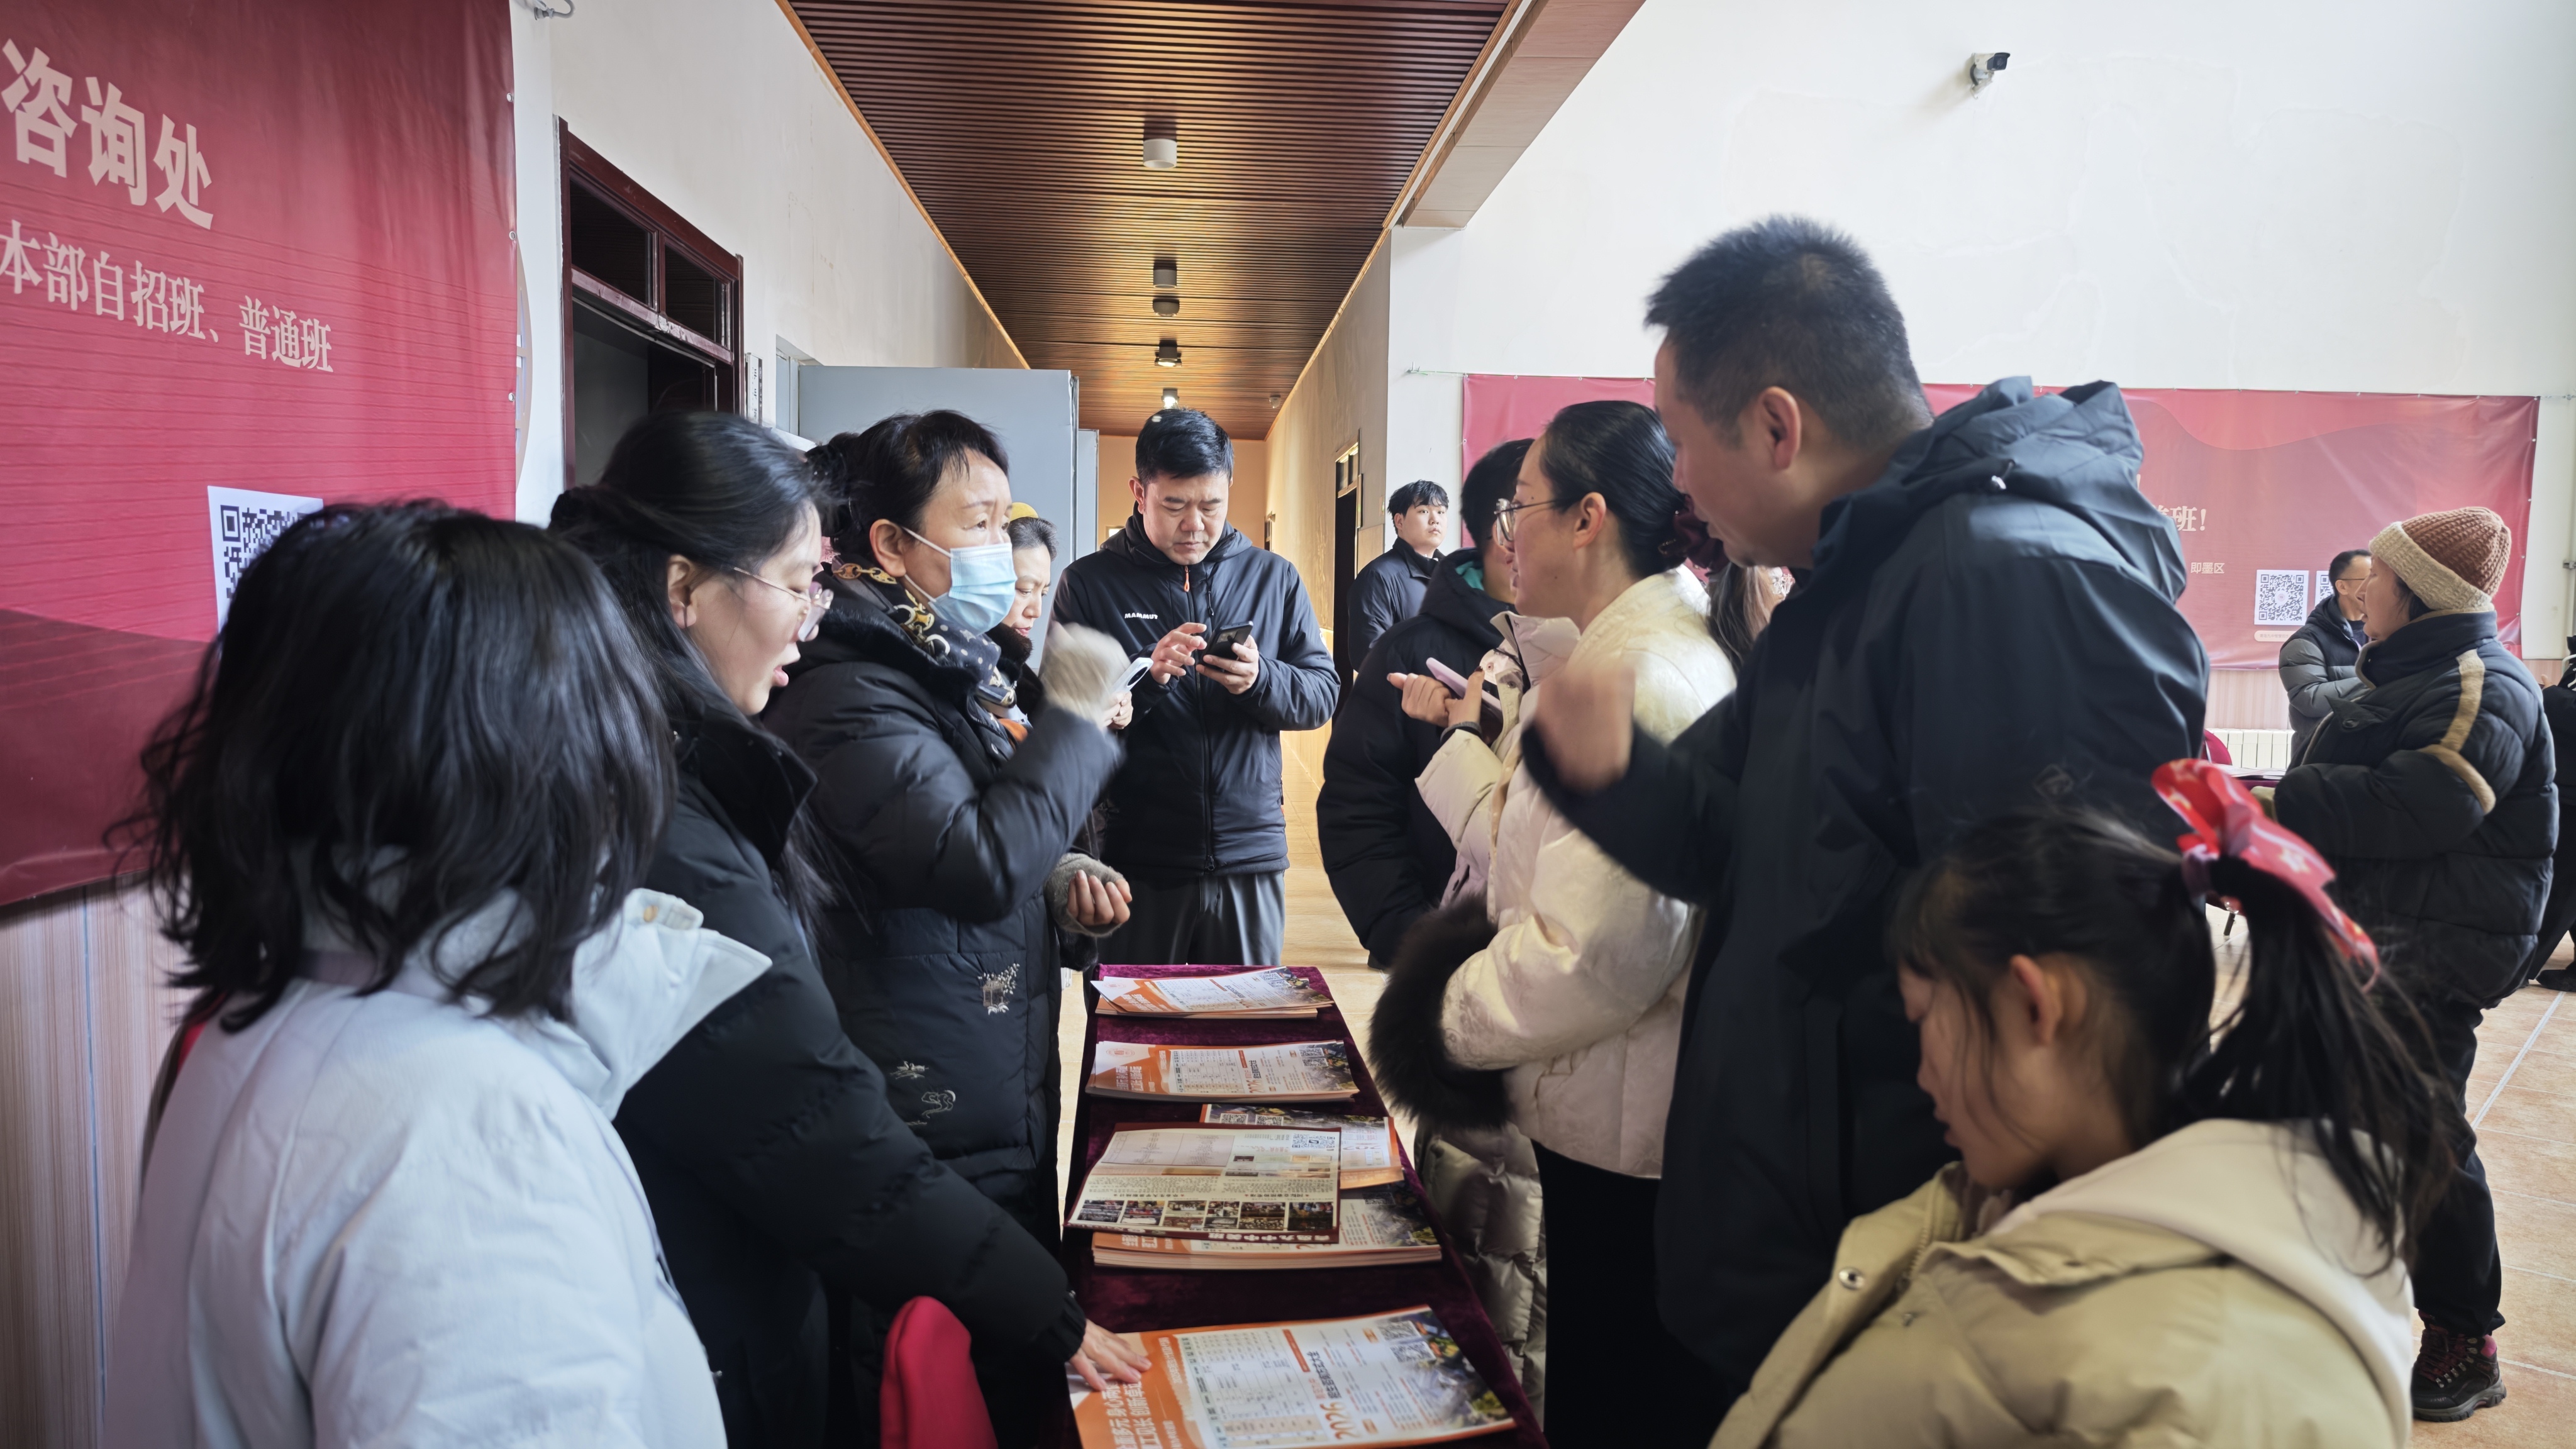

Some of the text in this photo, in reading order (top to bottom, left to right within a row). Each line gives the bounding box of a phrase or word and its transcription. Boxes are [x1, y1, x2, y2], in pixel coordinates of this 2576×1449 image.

[1, 38, 214, 230] 咨询处
[2190, 562, 2225, 574] 即墨区
[1319, 1401, 1362, 1440] 2026
